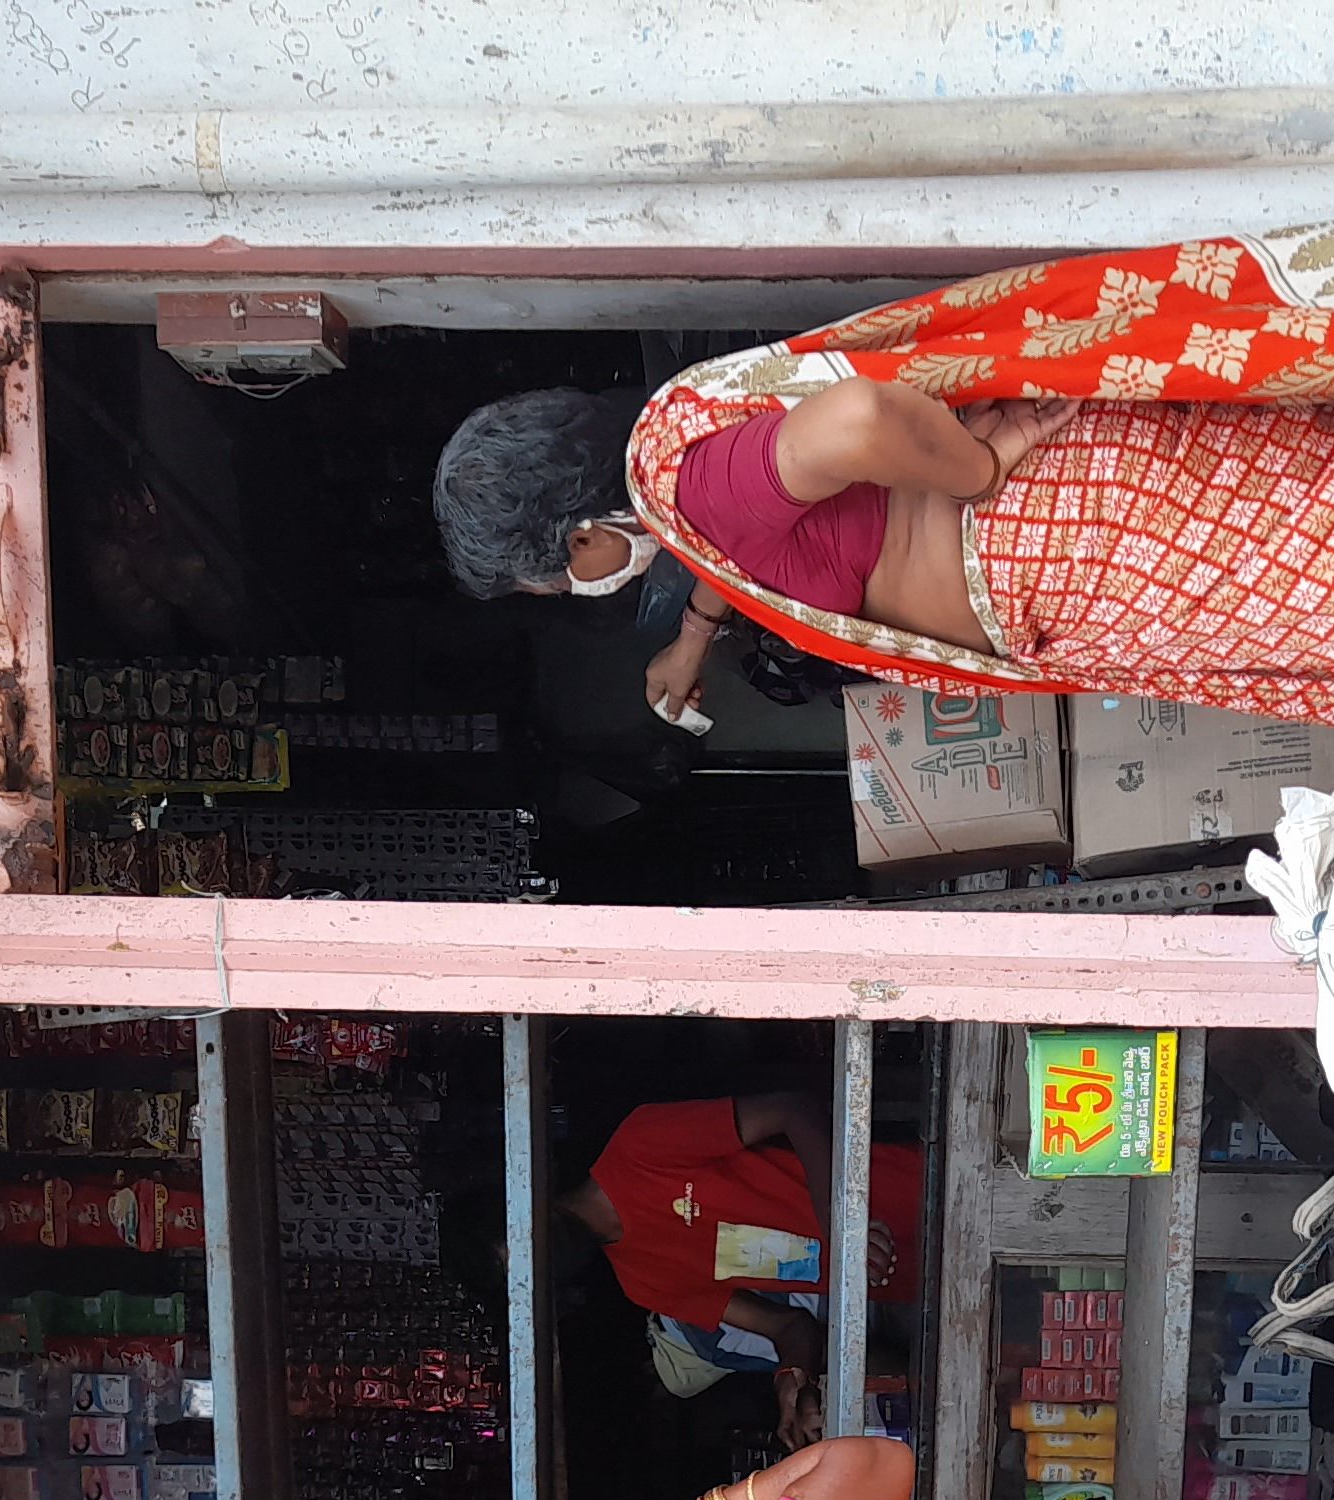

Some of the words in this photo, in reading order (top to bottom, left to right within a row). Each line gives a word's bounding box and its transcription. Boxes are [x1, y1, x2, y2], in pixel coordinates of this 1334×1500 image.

[1159, 1043, 1170, 1078] PACK
[1157, 1080, 1169, 1126] POUCH
[1156, 1130, 1168, 1159] NEW
